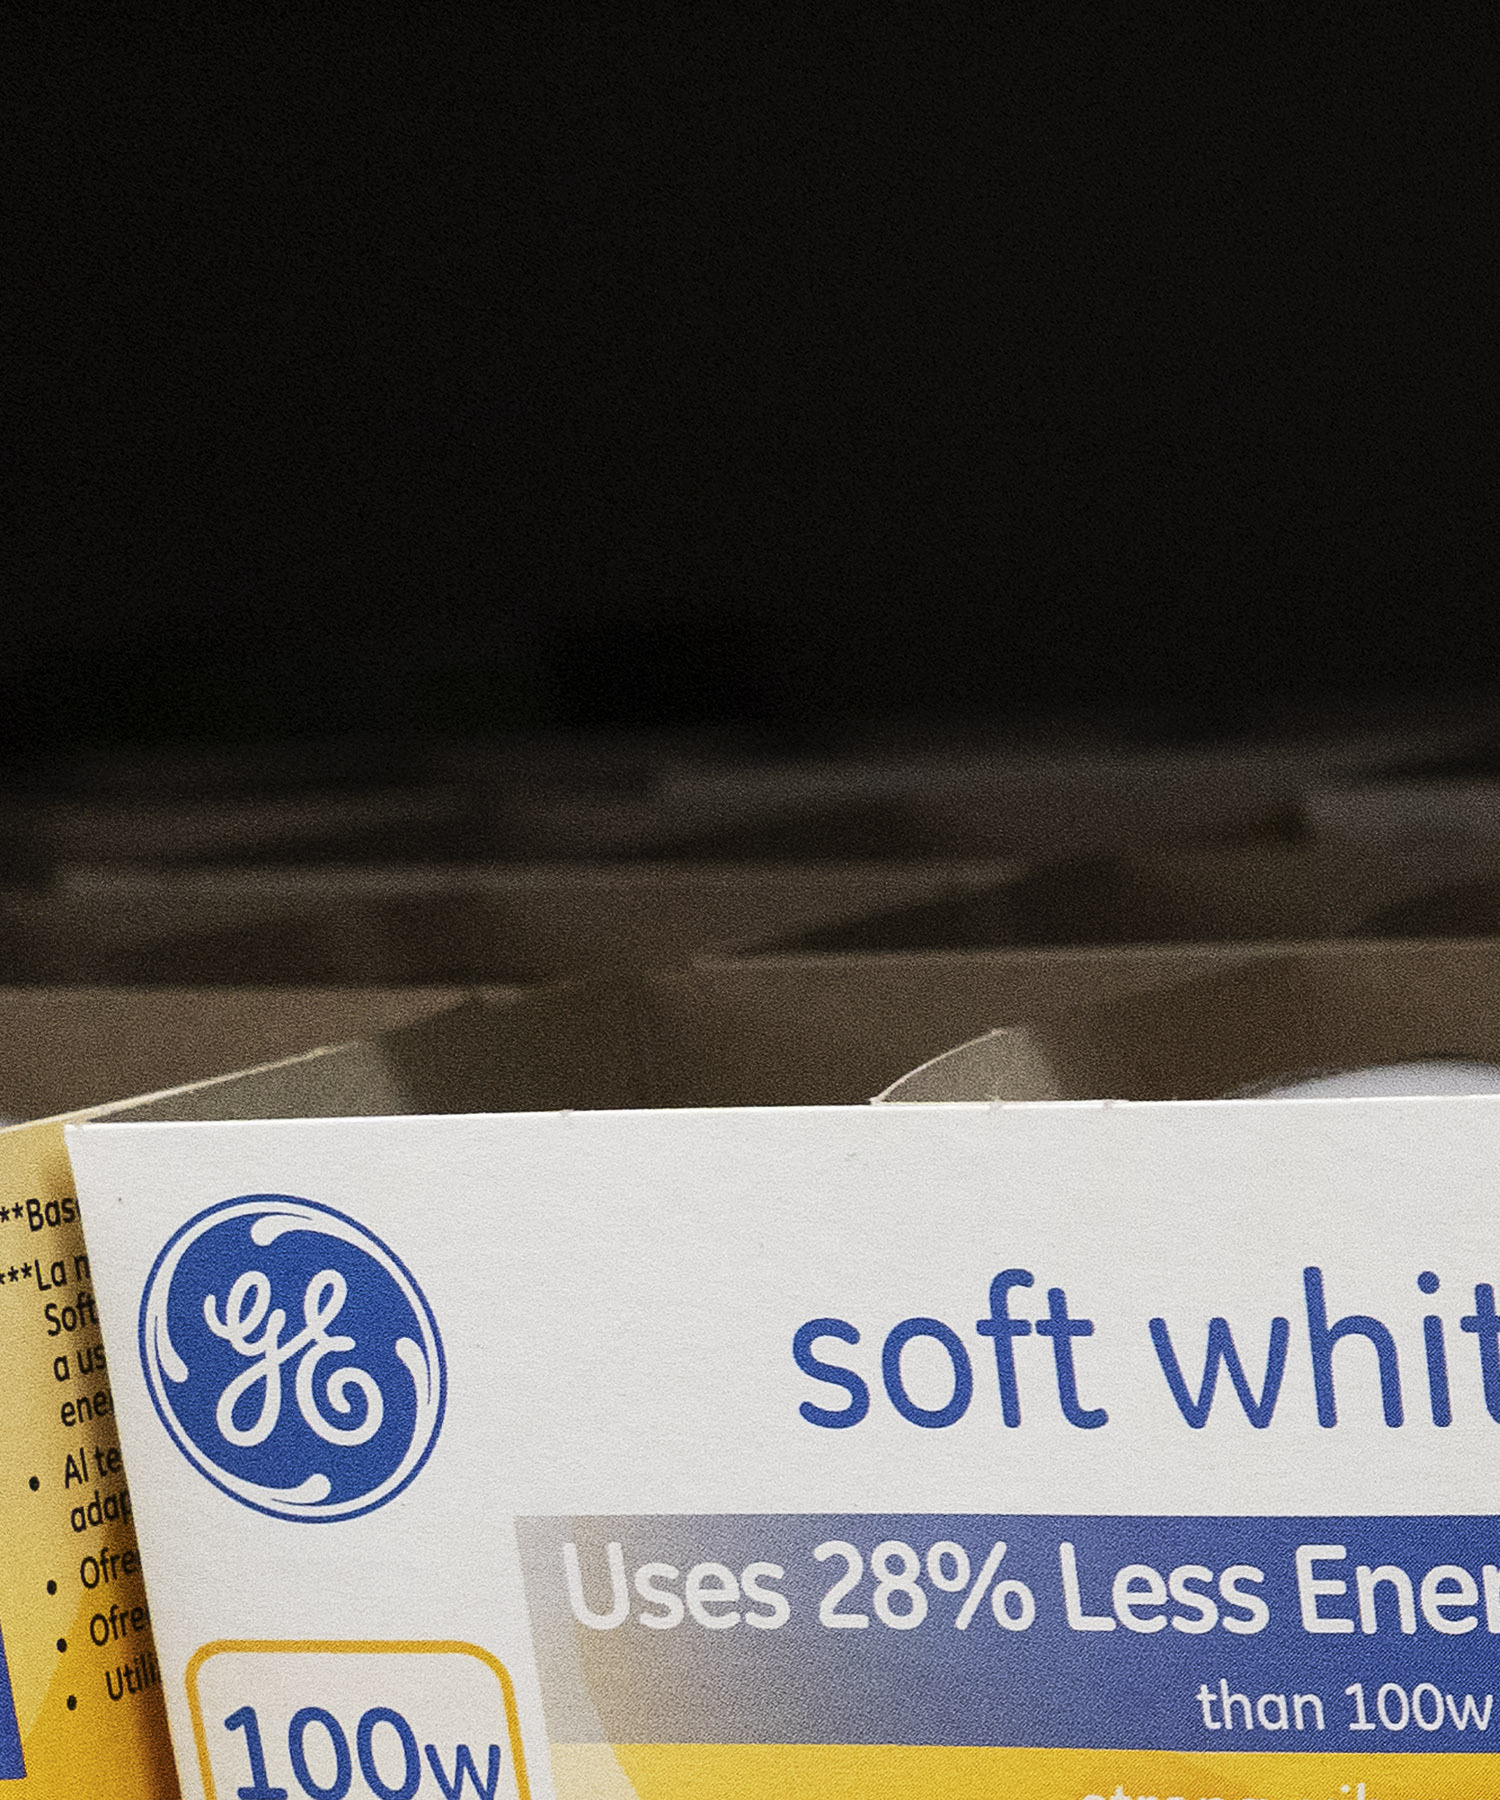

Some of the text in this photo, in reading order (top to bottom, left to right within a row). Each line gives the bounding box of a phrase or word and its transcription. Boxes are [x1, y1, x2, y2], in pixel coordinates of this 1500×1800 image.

[792, 1268, 1110, 1431] soft
[564, 1542, 791, 1631] Uses
[817, 1542, 1036, 1631] 28%
[1060, 1542, 1267, 1633] Less
[1198, 1680, 1325, 1731] than
[1345, 1682, 1492, 1731] 100w
